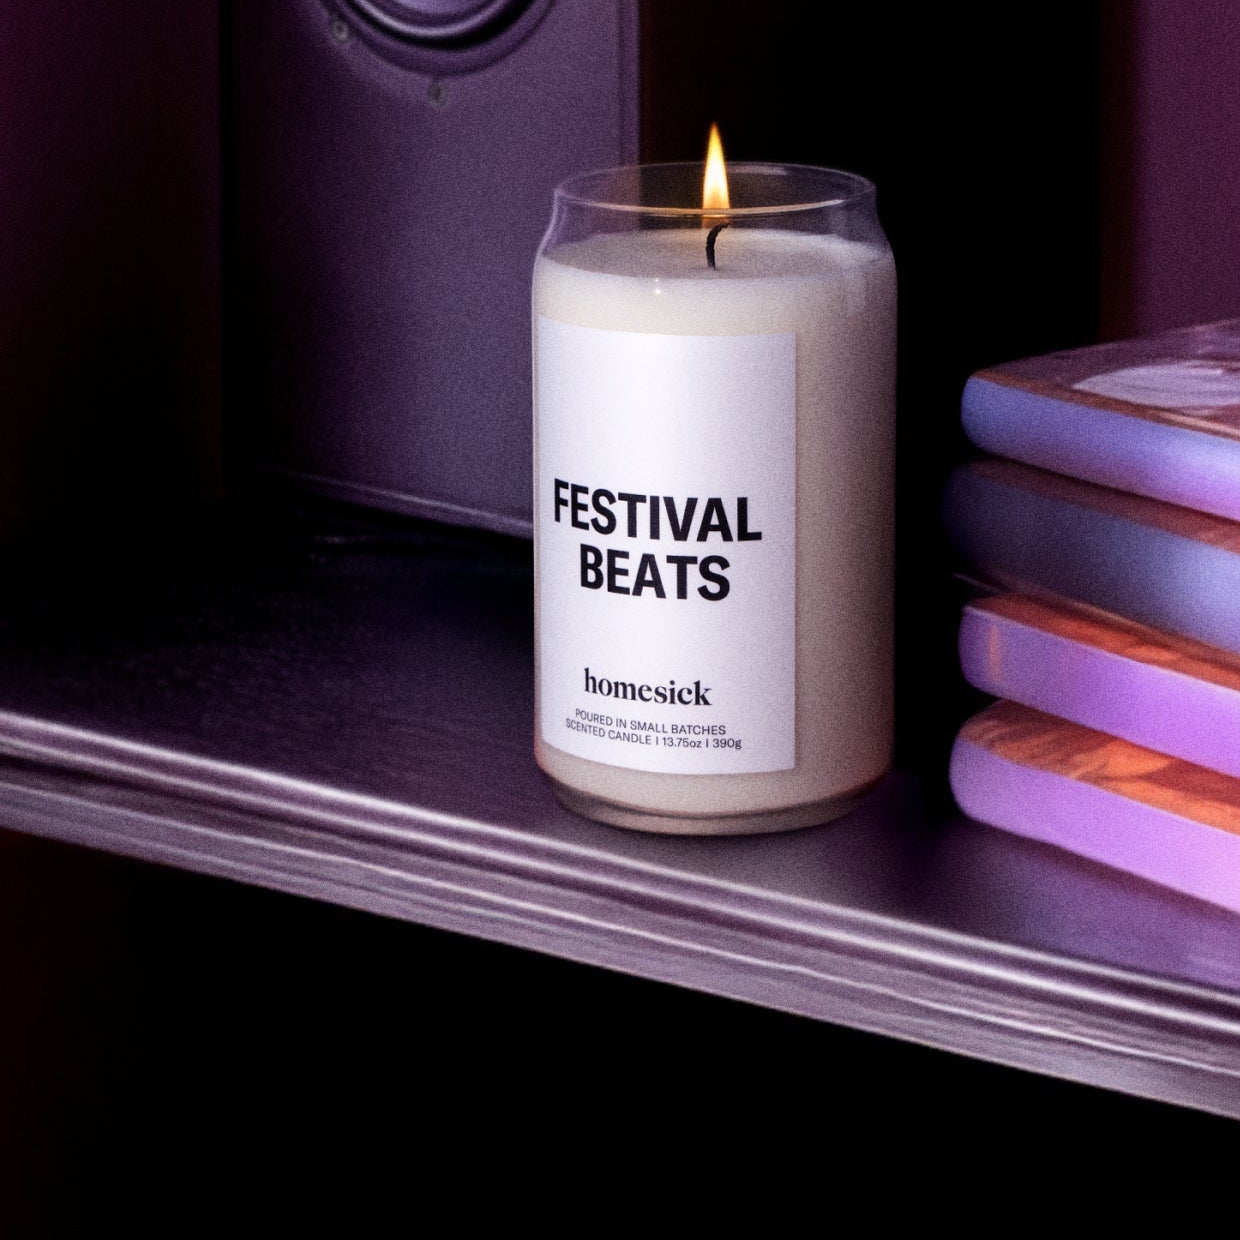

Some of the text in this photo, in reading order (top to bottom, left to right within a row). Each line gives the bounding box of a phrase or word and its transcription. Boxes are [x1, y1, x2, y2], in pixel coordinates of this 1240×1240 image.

[554, 478, 763, 542] FESTIVAL
[580, 543, 731, 601] BEATS
[584, 667, 712, 706] homesick
[565, 718, 606, 738] SCENTED
[608, 730, 652, 745] CANDLE
[662, 737, 702, 749] 13.75oz
[712, 738, 742, 749] 390g
[575, 708, 727, 736] POURED IN SMALL BATCHES
